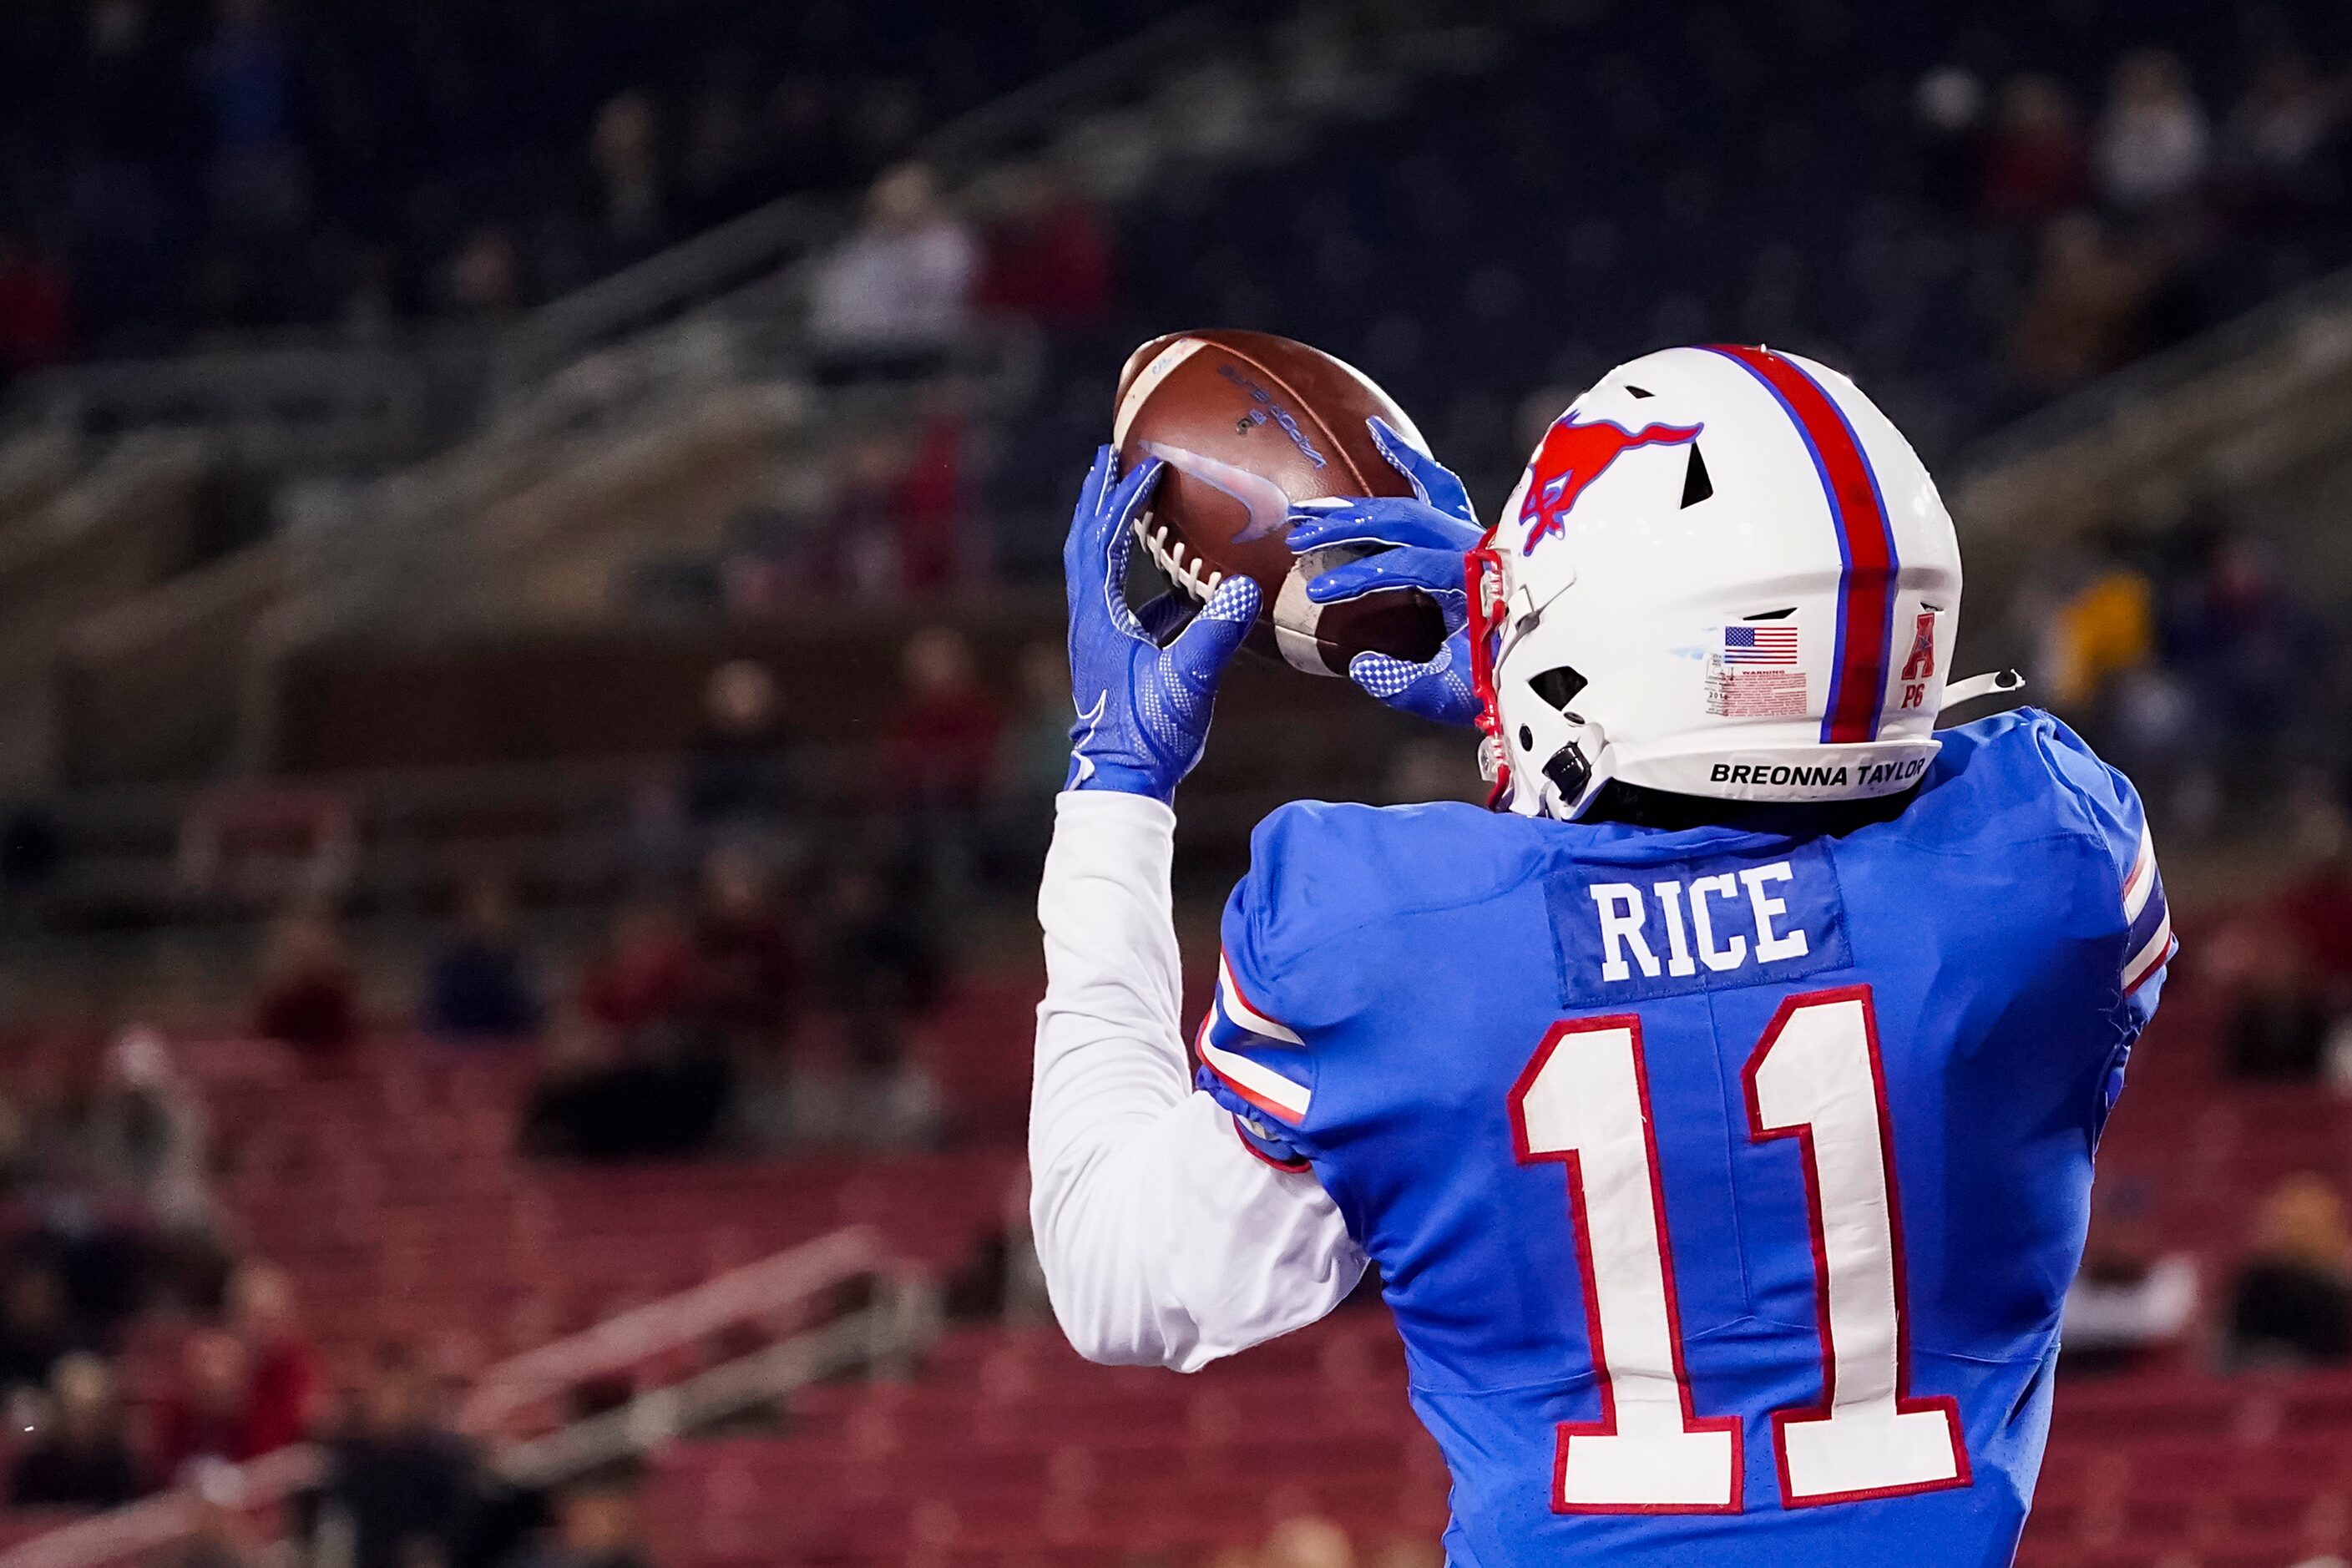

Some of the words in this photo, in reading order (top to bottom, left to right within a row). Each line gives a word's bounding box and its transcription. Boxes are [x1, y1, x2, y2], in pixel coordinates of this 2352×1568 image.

[1901, 613, 1935, 680] A
[1901, 683, 1925, 709] P6
[1711, 763, 1848, 787] BREONNA
[1858, 757, 1926, 786] TAYLOR
[1590, 861, 1808, 983] RICE
[1507, 984, 1974, 1515] 11
